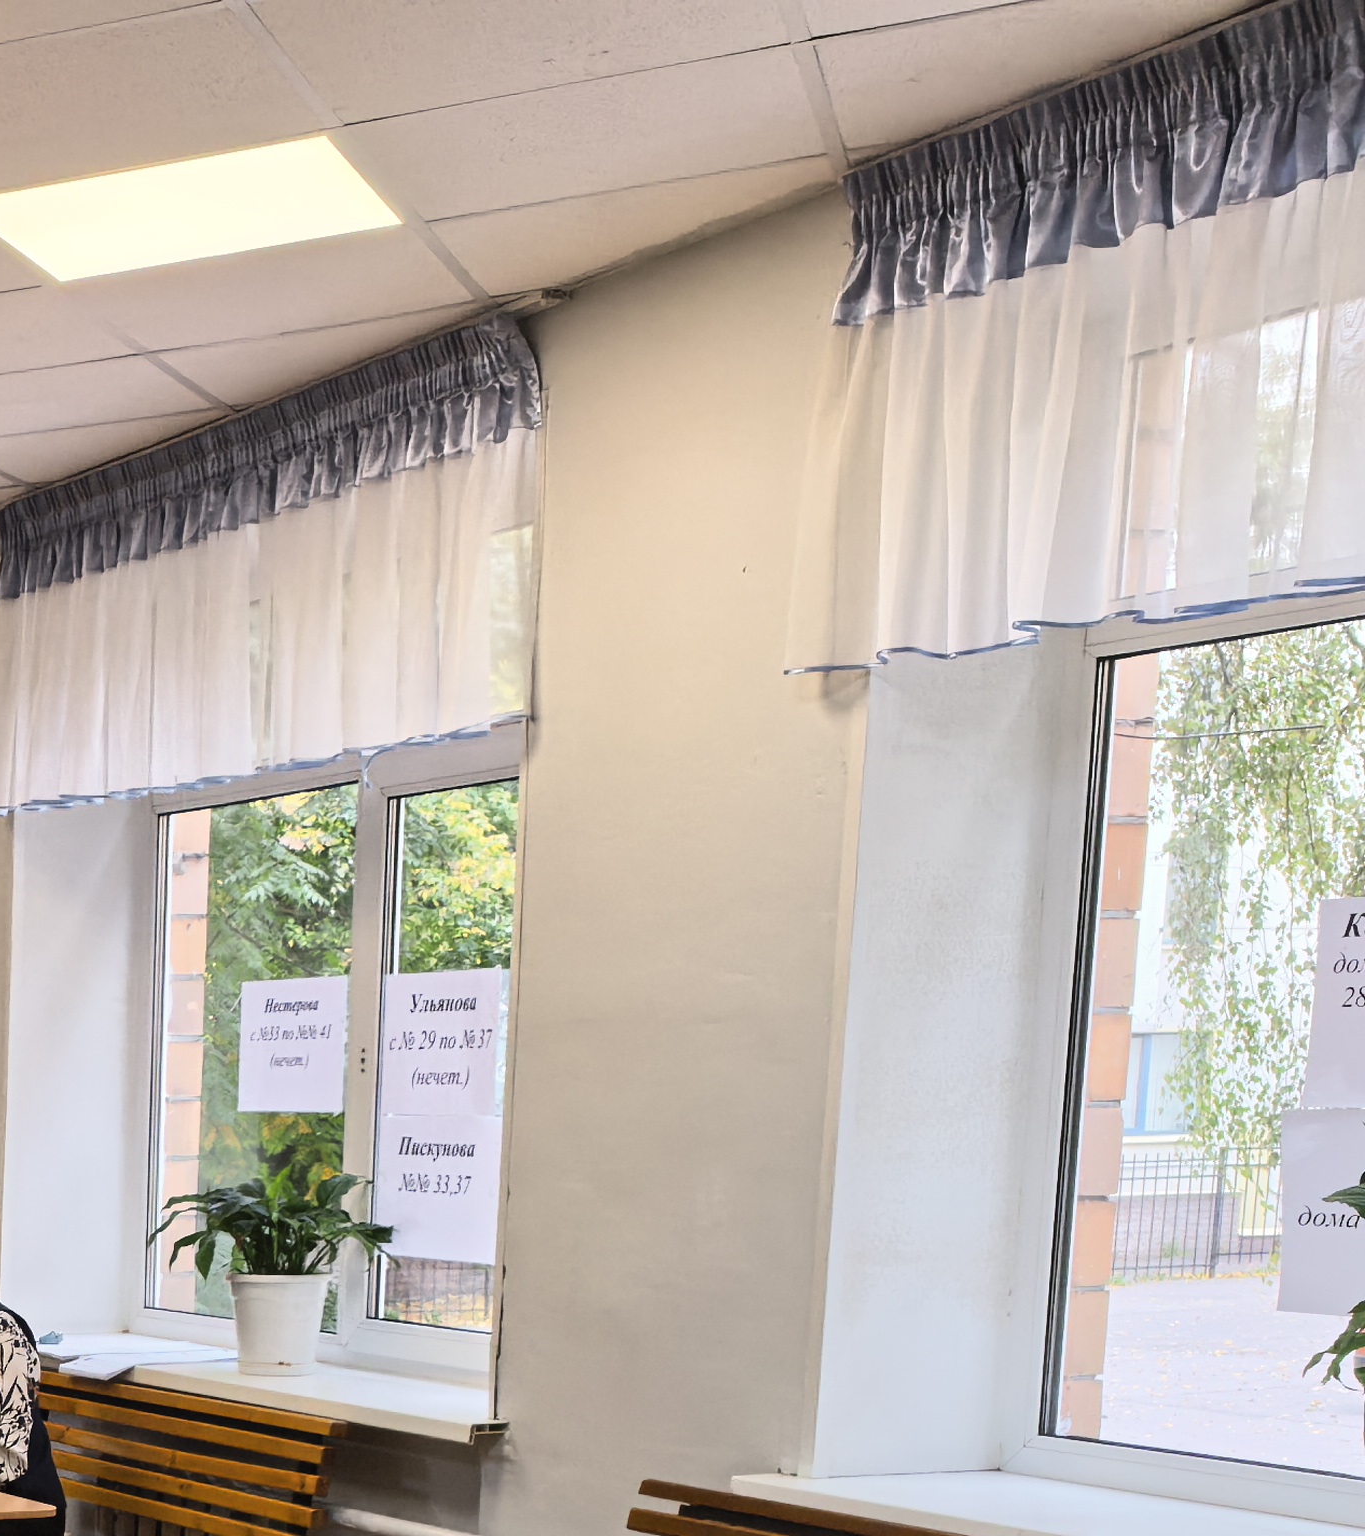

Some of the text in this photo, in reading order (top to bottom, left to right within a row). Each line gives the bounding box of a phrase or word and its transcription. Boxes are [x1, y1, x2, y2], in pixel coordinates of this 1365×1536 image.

[1342, 913, 1365, 938] К
[410, 993, 477, 1014] Ульянова
[418, 1030, 436, 1050] 29
[439, 1036, 456, 1049] по
[411, 1066, 470, 1090] (нечет.)
[398, 1136, 476, 1162] Пискунова
[1298, 1204, 1360, 1229] дома
